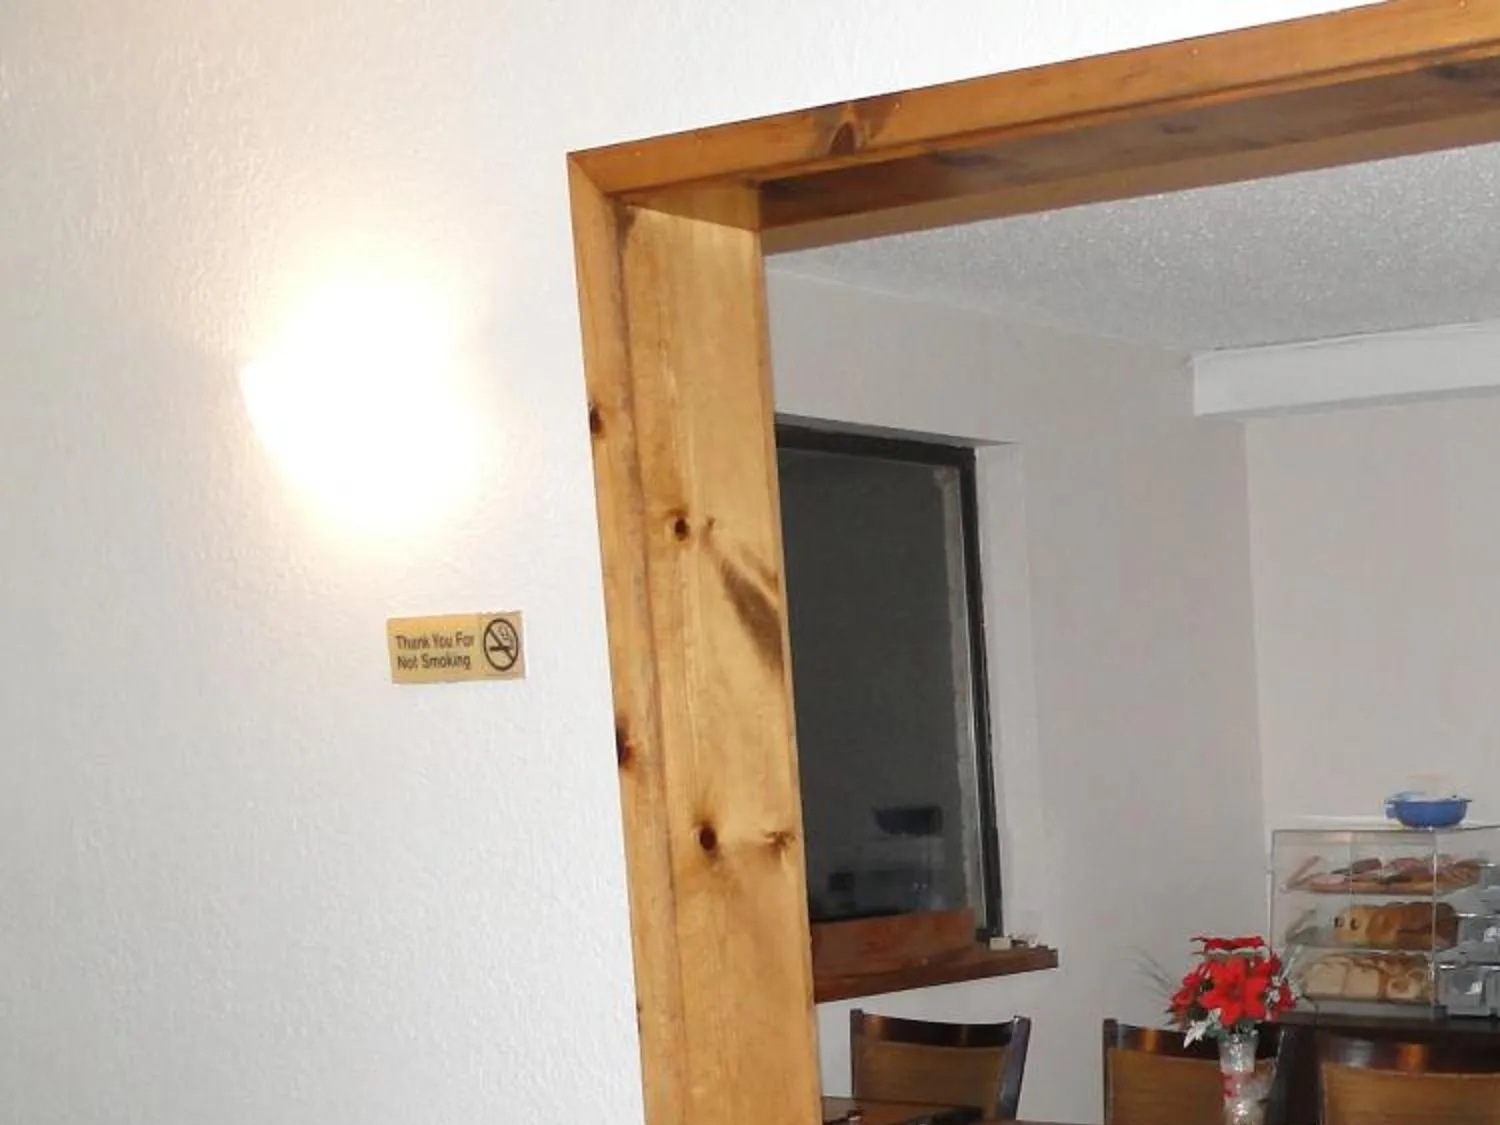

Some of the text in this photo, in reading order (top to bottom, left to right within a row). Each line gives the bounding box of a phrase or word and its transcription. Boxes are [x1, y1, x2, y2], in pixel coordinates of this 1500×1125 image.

[395, 631, 475, 650] Thank You For
[397, 652, 471, 671] Not Smoking
